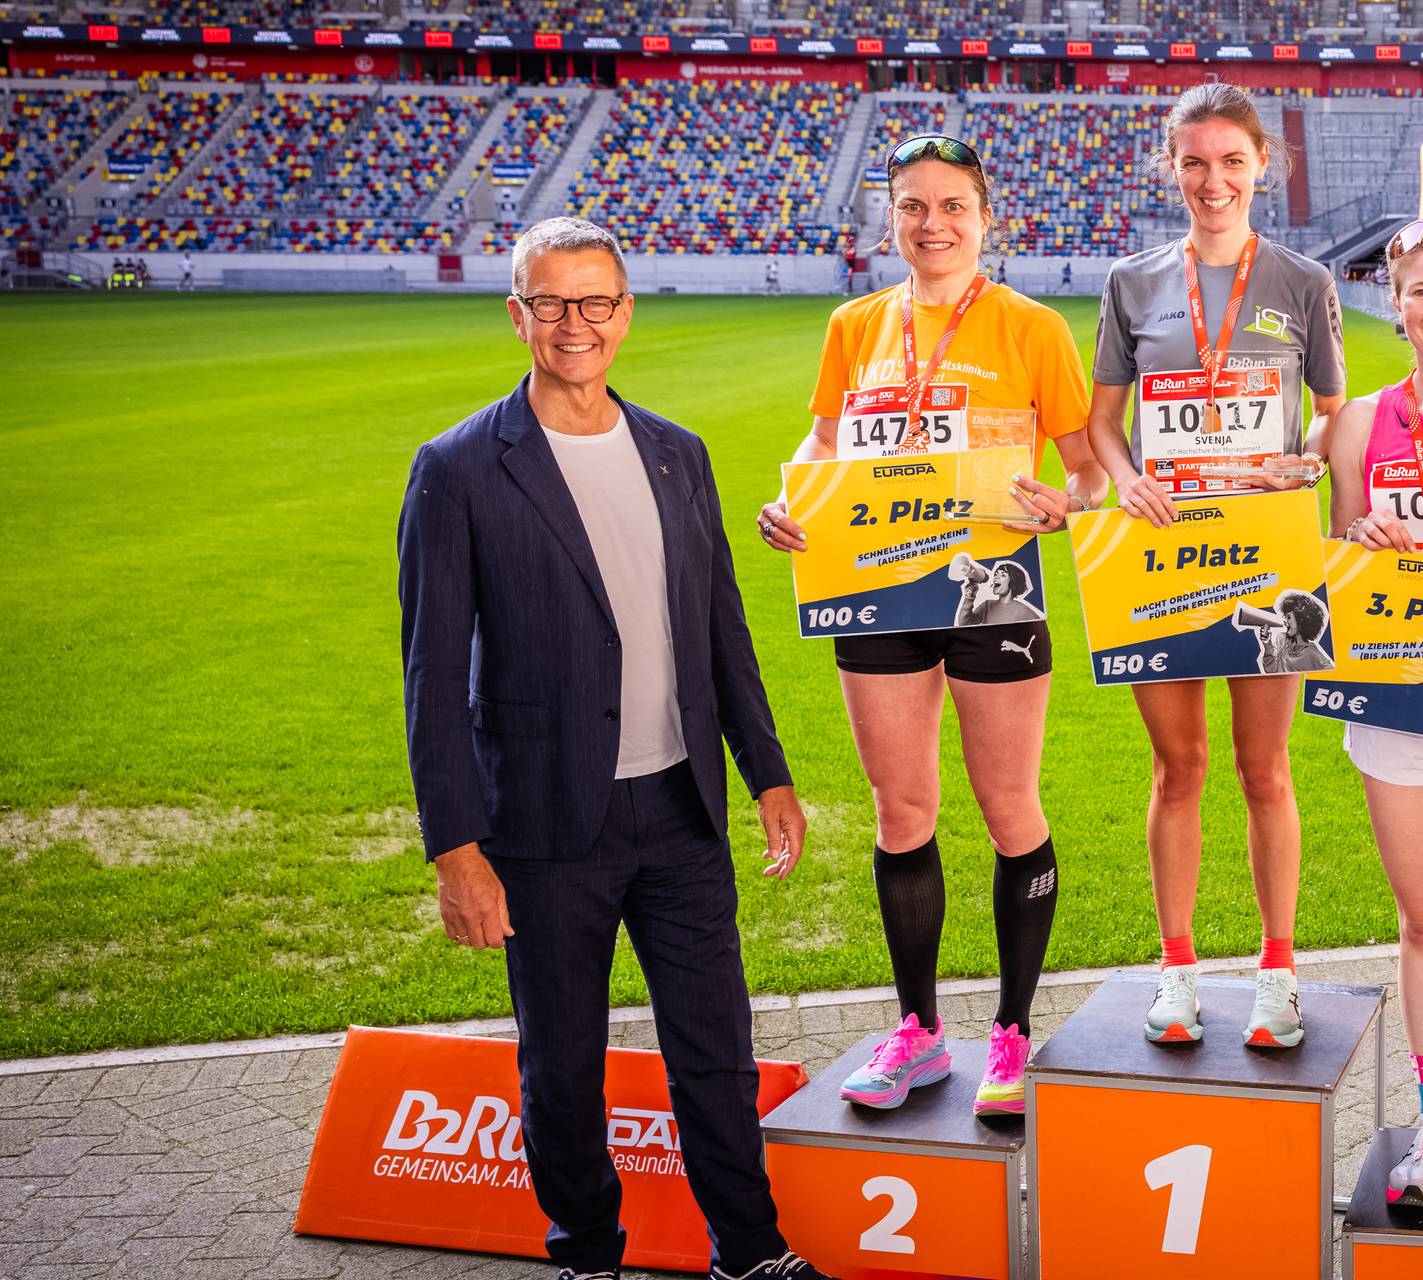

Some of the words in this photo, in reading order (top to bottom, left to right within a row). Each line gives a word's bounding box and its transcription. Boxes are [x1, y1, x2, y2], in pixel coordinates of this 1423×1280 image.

[1157, 310, 1185, 322] JAKO
[1152, 378, 1186, 390] B2Run
[1157, 400, 1268, 434] 1017
[1195, 435, 1233, 446] SVENJA
[873, 463, 936, 478] EUROPA
[850, 503, 877, 527] 2.
[889, 497, 974, 524] Platz
[1172, 508, 1224, 522] UROPA
[858, 541, 912, 562] SCHNELLER
[914, 535, 937, 548] WAR
[940, 527, 969, 541] KEINE
[877, 550, 918, 567] (AUSSER
[920, 542, 949, 557] EINE)!
[1144, 549, 1164, 572] 1.
[1176, 544, 1260, 570] Platz
[1134, 600, 1167, 615] MACHT
[1170, 584, 1229, 605] ORDENTLICH
[1231, 572, 1269, 589] RABATZ
[1149, 608, 1167, 621] FÜR
[1170, 605, 1189, 616] DEN
[1192, 594, 1227, 610] ERSTEN
[1229, 585, 1261, 600] PLATZ!
[1366, 592, 1394, 617] 3.
[808, 608, 852, 628] 100
[857, 605, 878, 625] €
[1352, 642, 1366, 650] DU
[1368, 642, 1401, 650] ZIEHST
[1402, 641, 1417, 649] AN
[1360, 651, 1379, 661] (BIS
[1380, 650, 1400, 659] AUF
[1101, 655, 1144, 676] 150
[1148, 652, 1169, 671] €
[1312, 688, 1345, 710] 50
[1348, 695, 1369, 715] €
[382, 1090, 528, 1162] B2Ru
[608, 1107, 681, 1150] DA
[373, 1155, 500, 1187] GEMEINSAM.
[1144, 1144, 1212, 1255] 1
[859, 1176, 918, 1255] 2
